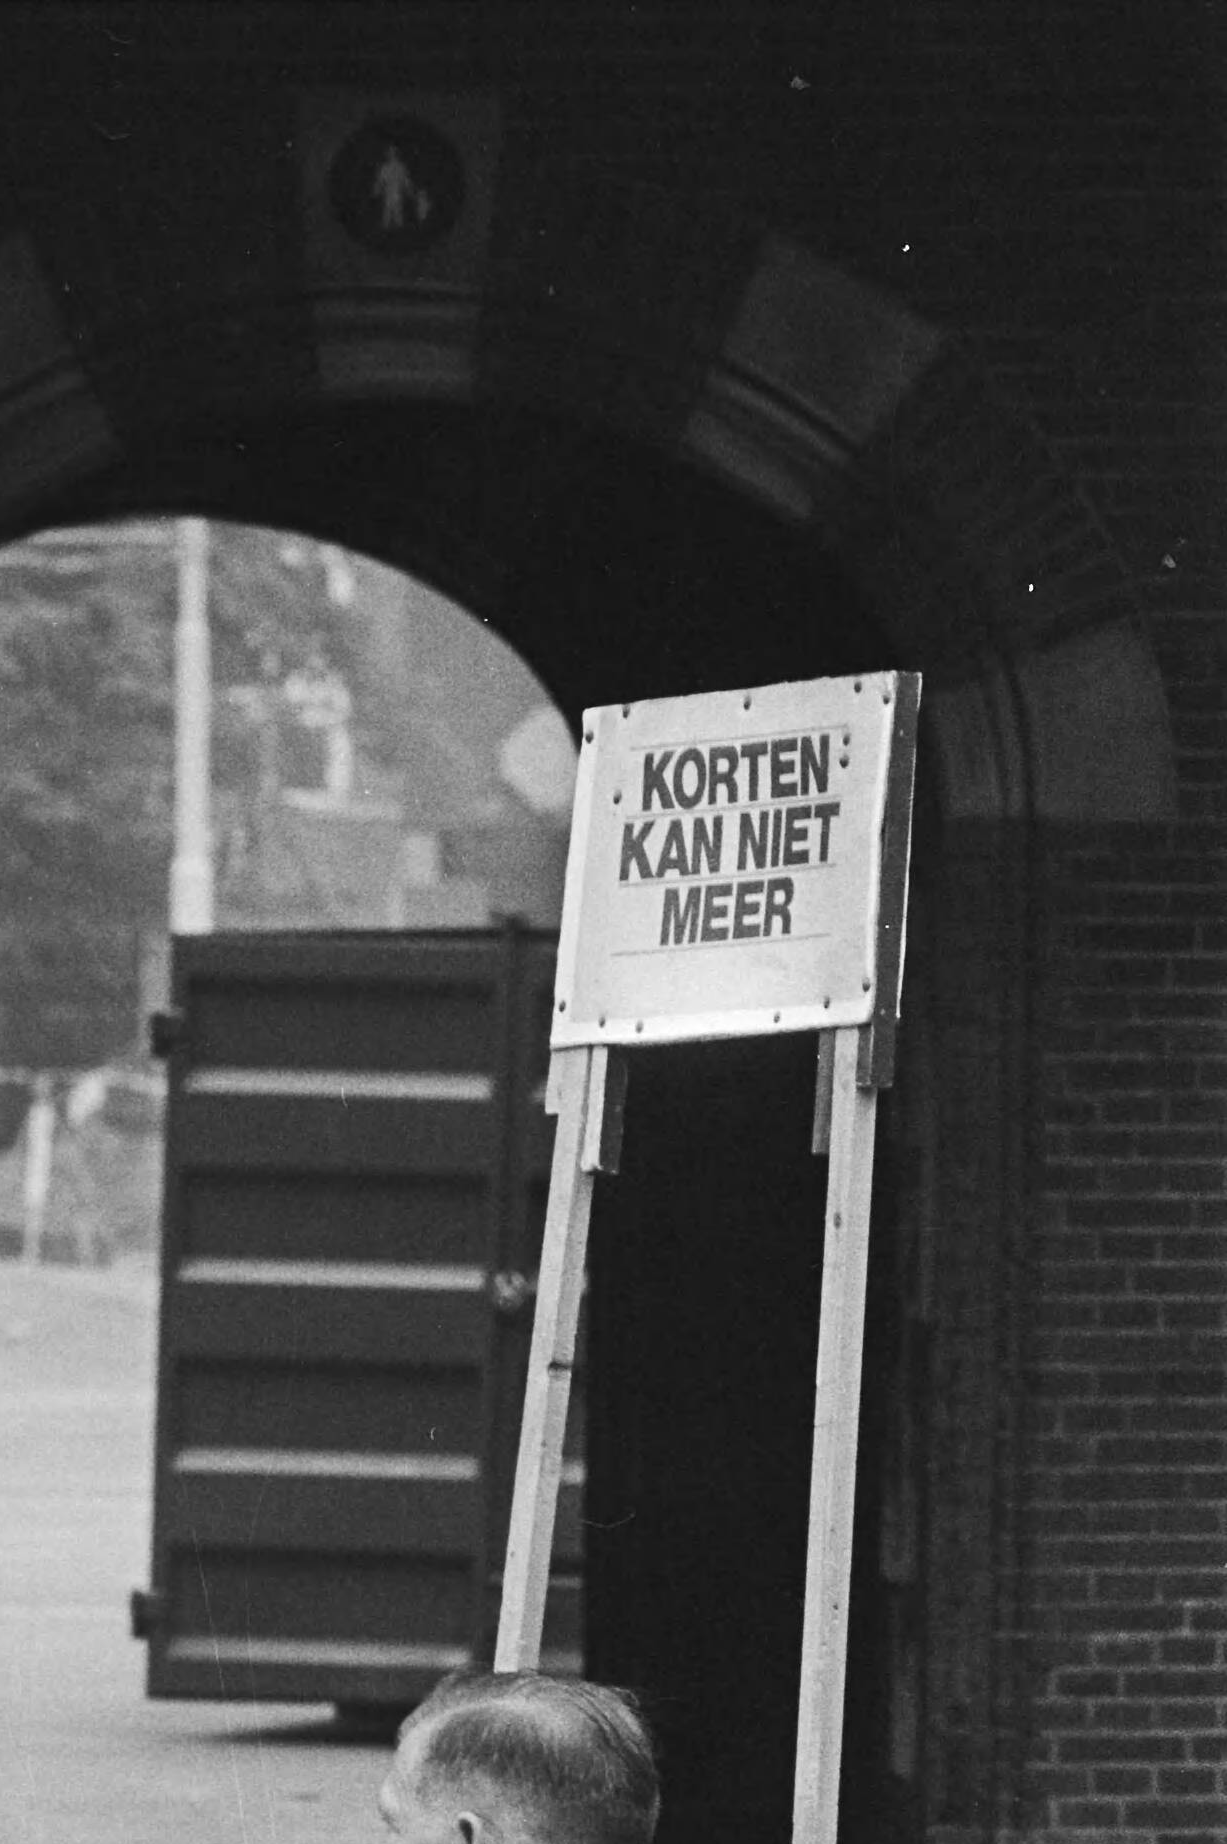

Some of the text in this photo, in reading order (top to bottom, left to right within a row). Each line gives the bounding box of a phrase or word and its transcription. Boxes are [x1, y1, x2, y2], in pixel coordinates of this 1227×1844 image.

[641, 733, 831, 812] KORTEN
[618, 801, 841, 882] KAN NIET
[659, 877, 795, 946] MEER
